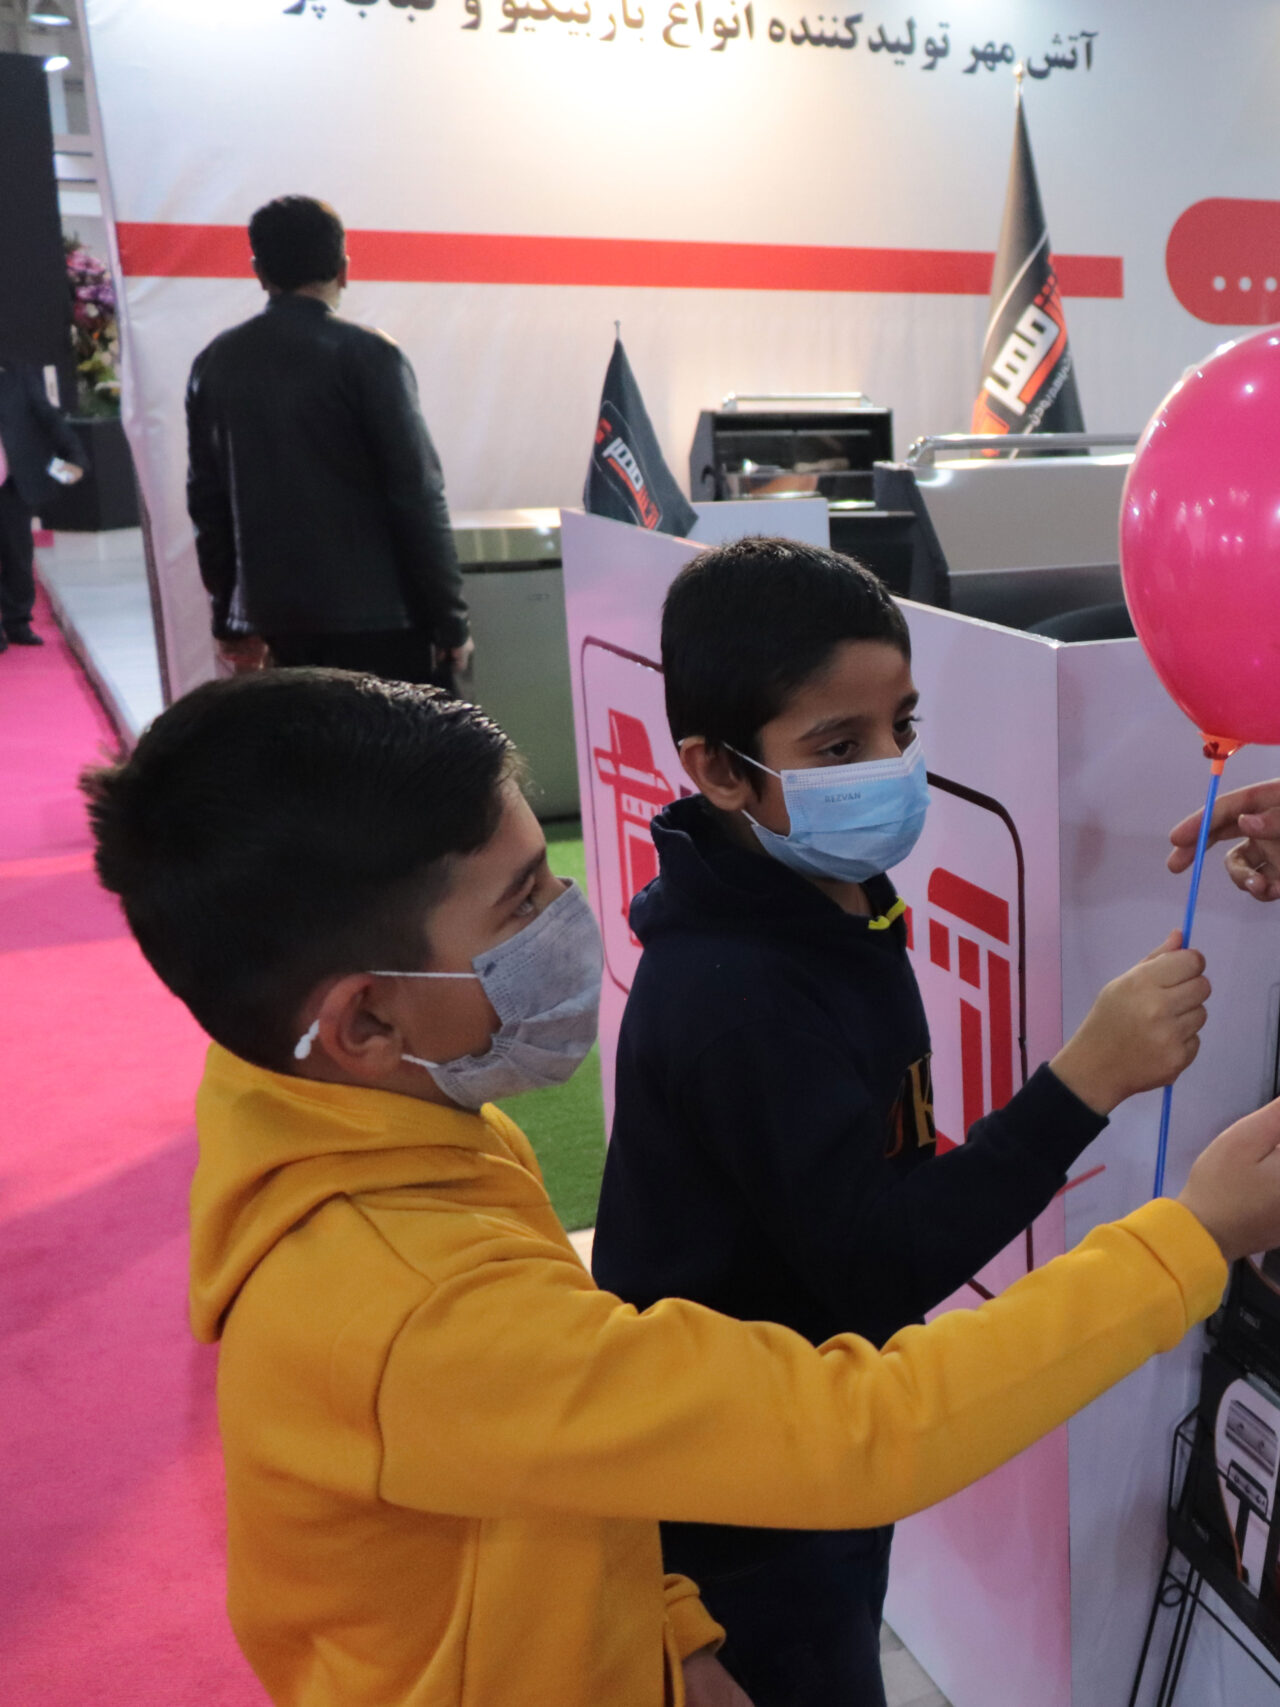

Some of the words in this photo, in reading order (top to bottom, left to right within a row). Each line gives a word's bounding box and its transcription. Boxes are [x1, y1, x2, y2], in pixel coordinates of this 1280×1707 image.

[662, 0, 755, 51] انواع
[962, 39, 1016, 75] مهر
[1026, 30, 1099, 79] آتش
